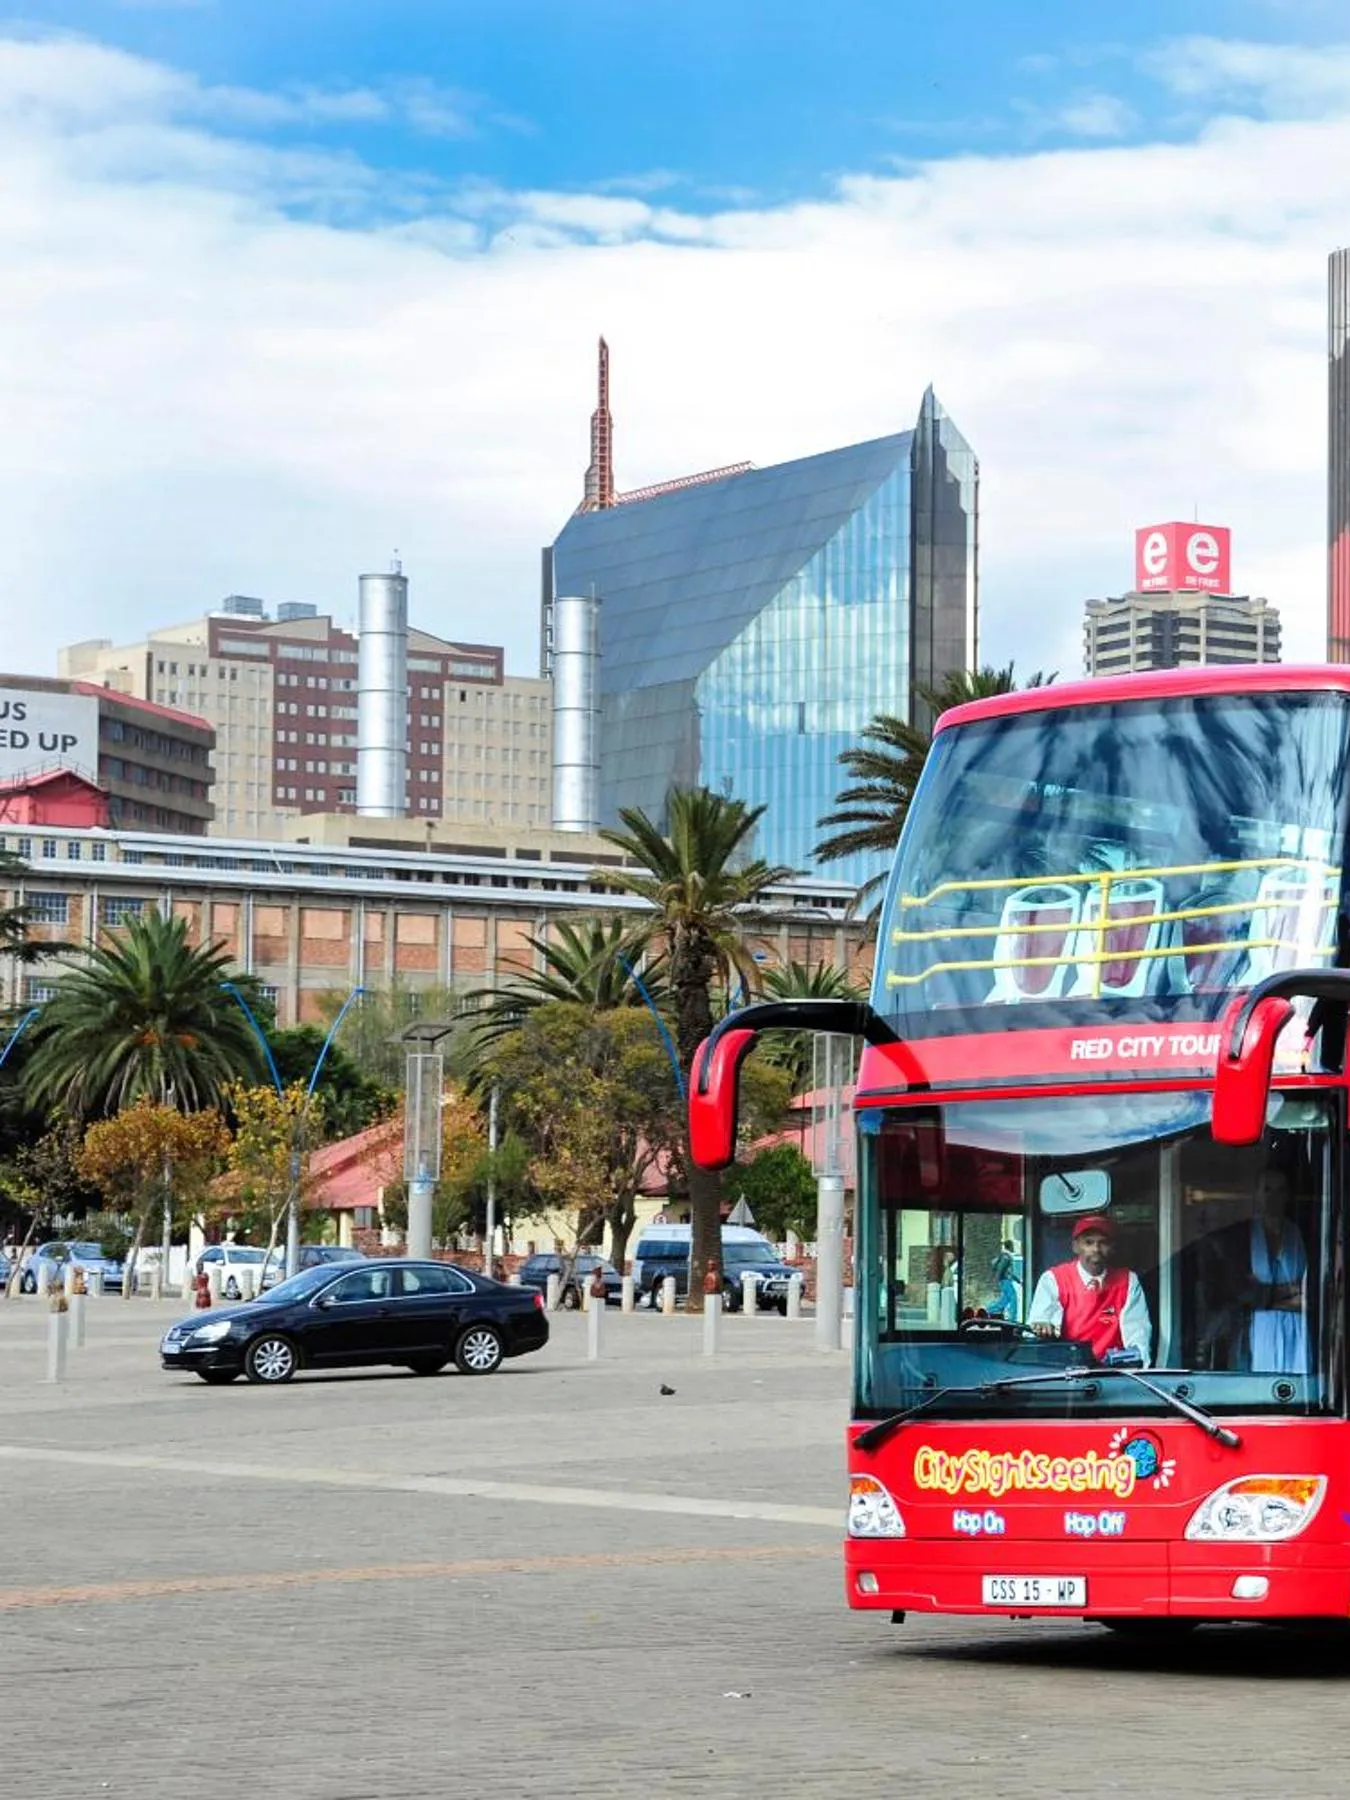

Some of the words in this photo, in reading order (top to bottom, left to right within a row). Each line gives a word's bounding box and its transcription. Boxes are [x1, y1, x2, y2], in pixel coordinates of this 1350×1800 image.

[1143, 532, 1167, 574] e
[1186, 532, 1219, 574] e
[39, 732, 78, 752] UP
[1071, 1039, 1113, 1060] RED
[1118, 1037, 1164, 1058] CITY
[953, 1509, 982, 1536] Hop
[983, 1509, 1005, 1534] On
[1064, 1511, 1096, 1537] Hop
[1098, 1509, 1126, 1536] Off
[991, 1579, 1016, 1600] CSS
[1023, 1580, 1040, 1601] 15
[1058, 1580, 1075, 1601] WP
